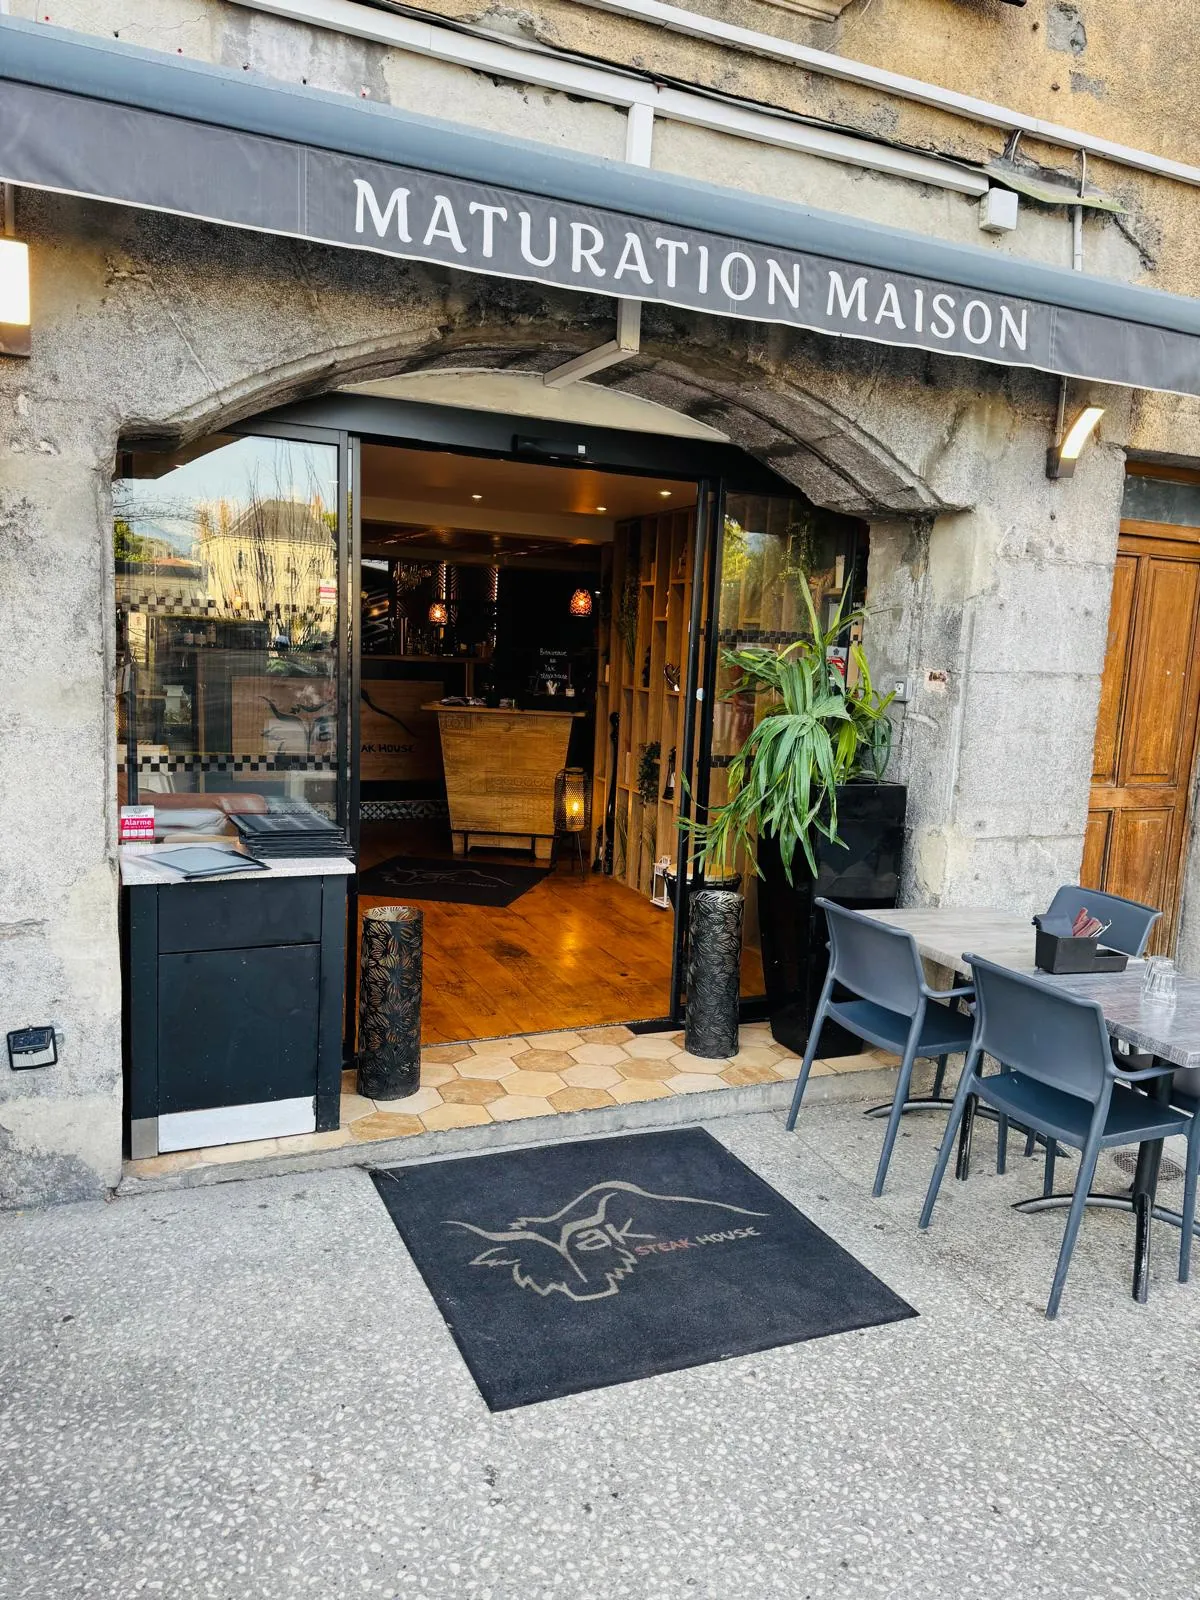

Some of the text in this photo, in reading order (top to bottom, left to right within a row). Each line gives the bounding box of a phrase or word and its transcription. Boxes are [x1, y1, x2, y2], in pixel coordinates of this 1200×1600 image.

[353, 179, 1028, 350] MATURATION MAISON
[378, 743, 416, 753] HOUSE
[633, 1226, 762, 1256] STEAK HOUSE
